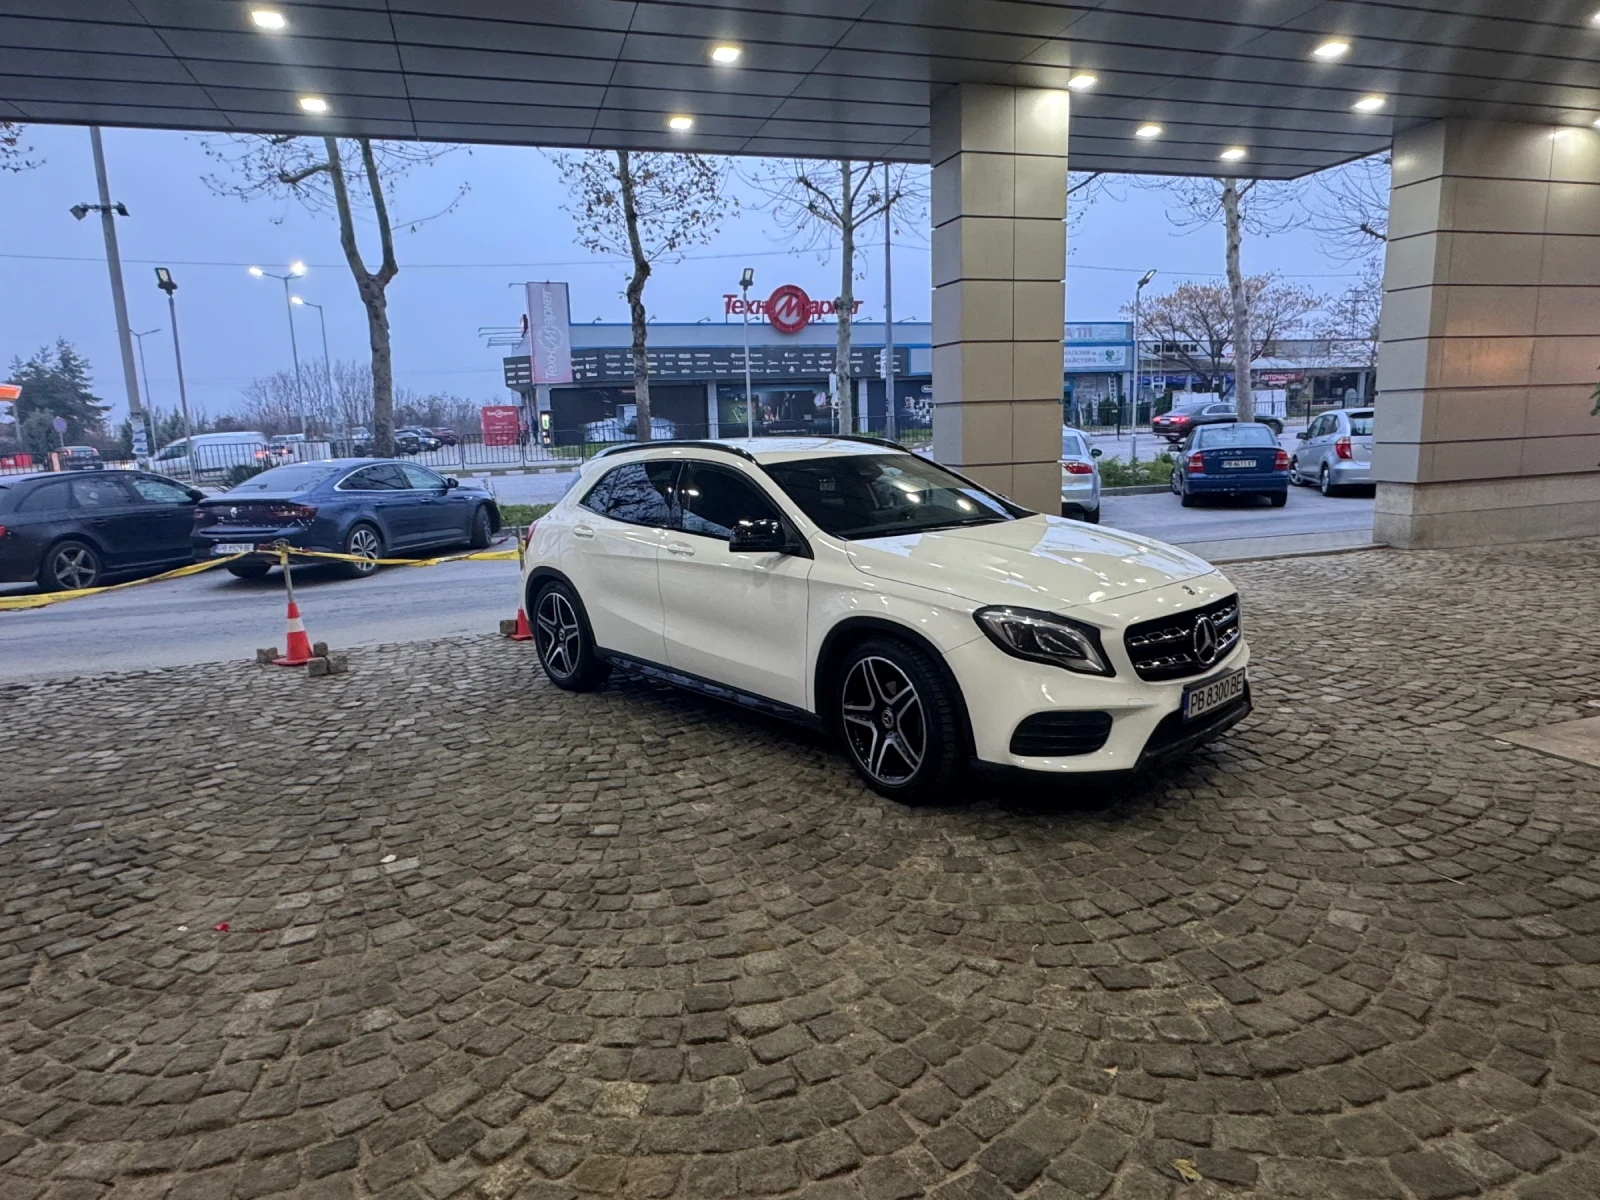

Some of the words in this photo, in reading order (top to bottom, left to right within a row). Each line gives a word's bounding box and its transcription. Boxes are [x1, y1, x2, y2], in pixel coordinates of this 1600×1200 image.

[1191, 691, 1204, 714] PB
[1207, 680, 1229, 706] 8300
[1231, 673, 1242, 695] BE
